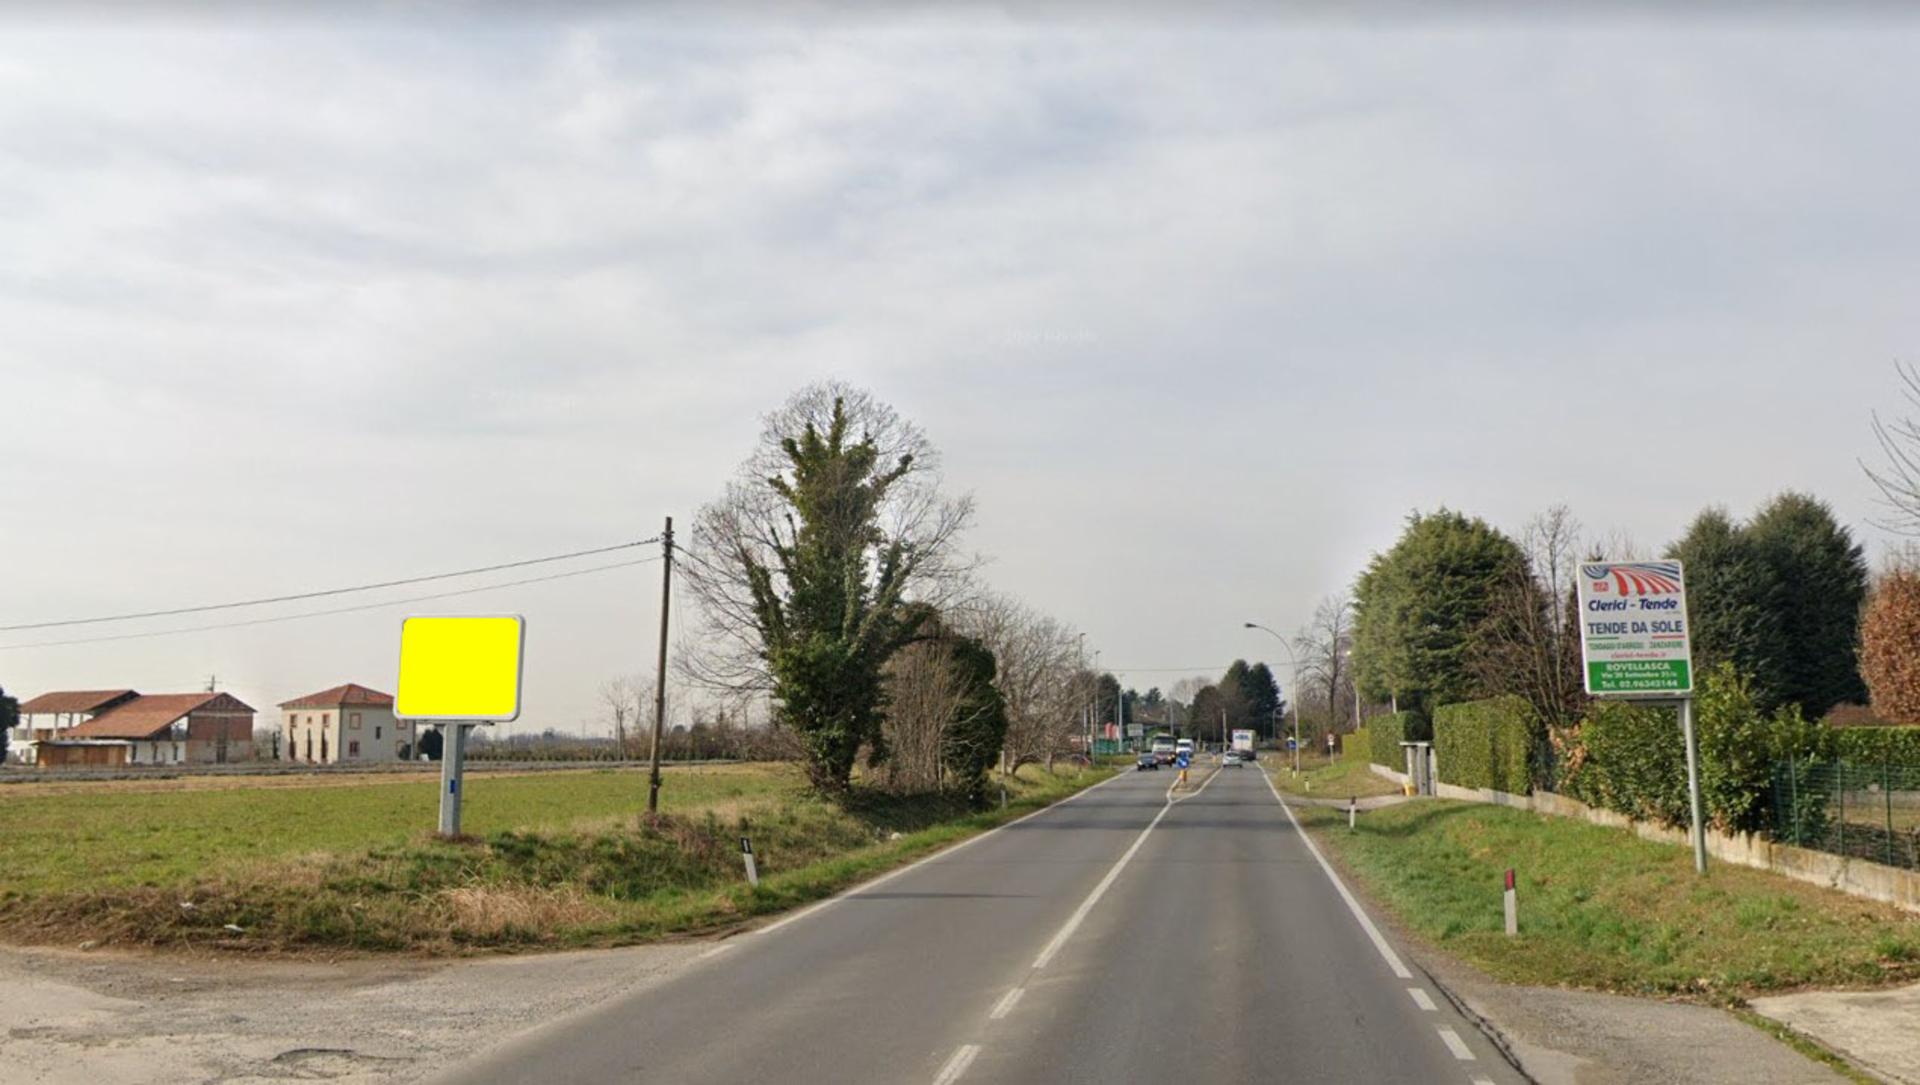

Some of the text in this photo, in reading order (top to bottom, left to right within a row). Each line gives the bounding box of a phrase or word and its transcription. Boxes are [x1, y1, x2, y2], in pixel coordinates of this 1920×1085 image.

[1588, 599, 1627, 611] Clerici
[1638, 598, 1677, 610] Tende
[1588, 620, 1683, 634] TENDE DA SOLE
[1606, 662, 1671, 671] ROVELLASCA
